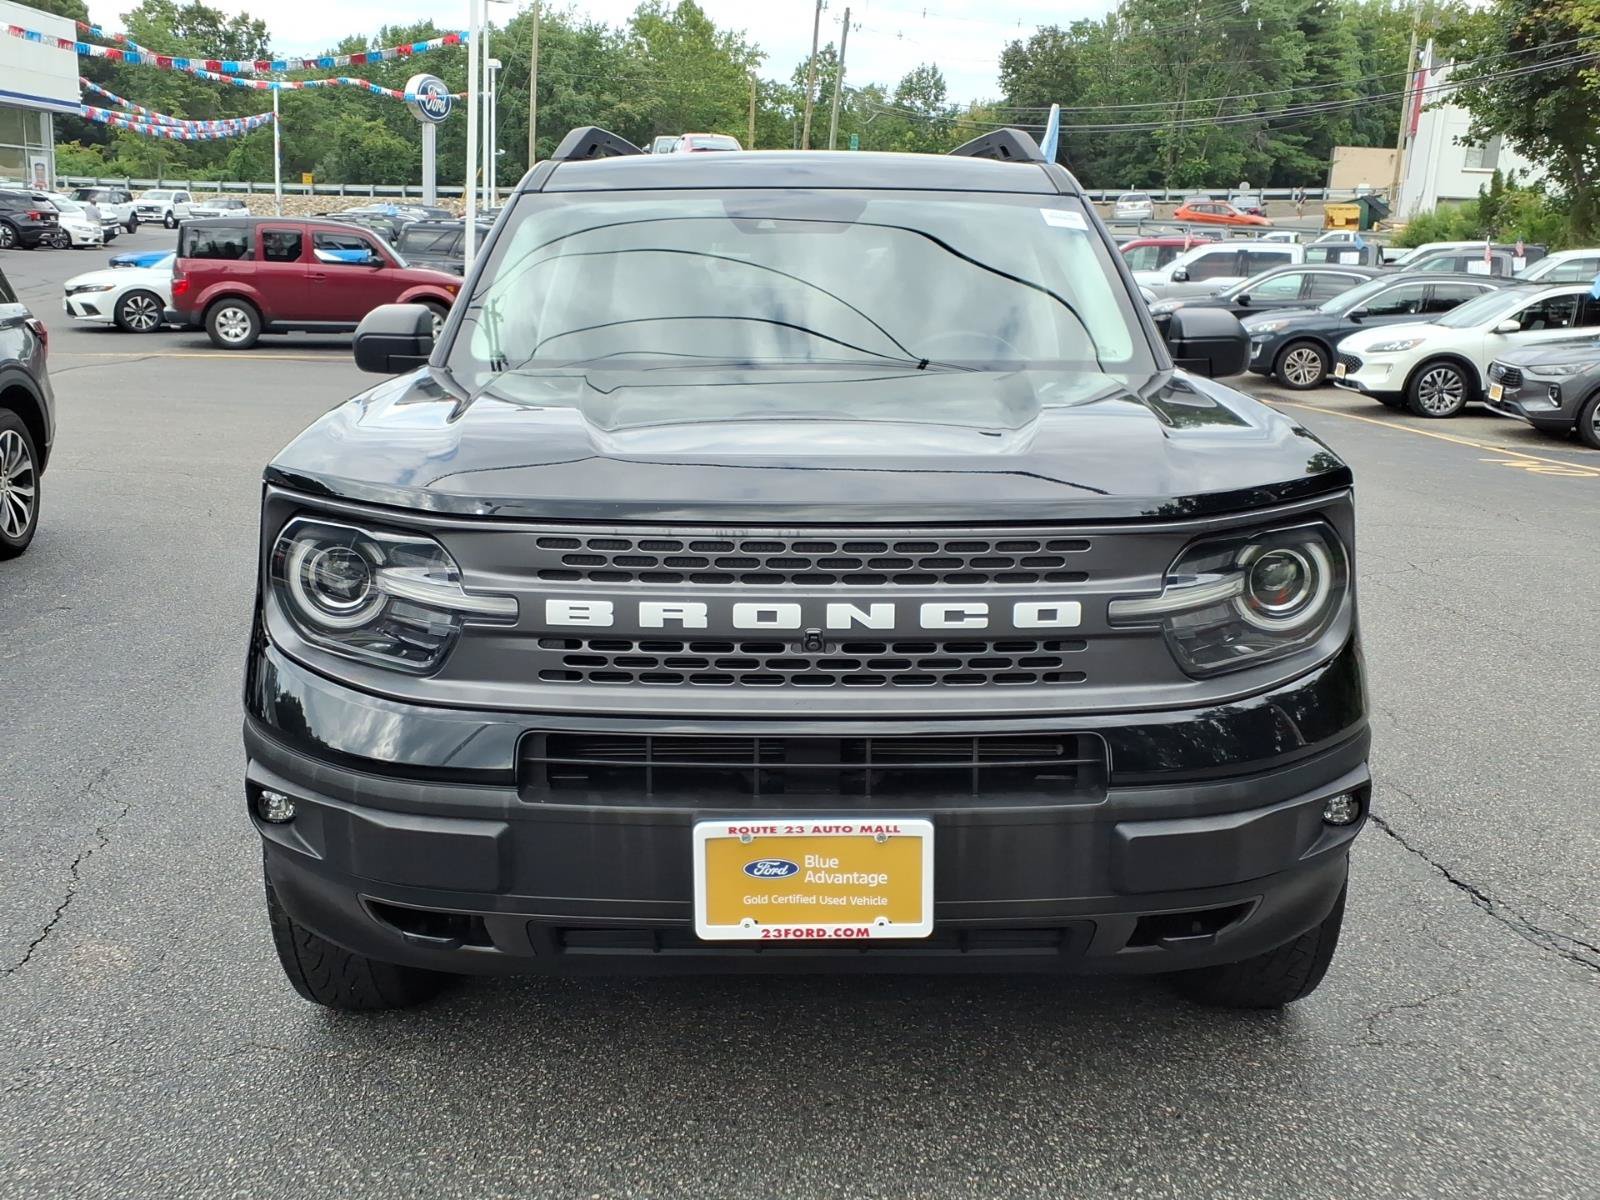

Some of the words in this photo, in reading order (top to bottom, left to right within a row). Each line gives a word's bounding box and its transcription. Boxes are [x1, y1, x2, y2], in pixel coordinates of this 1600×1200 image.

[545, 599, 1082, 629] BRONCO
[728, 826, 777, 835] ROUTE
[785, 826, 804, 834] 23
[811, 825, 853, 834] AUTO
[859, 825, 901, 833] MALL
[753, 860, 789, 876] Ford
[804, 855, 839, 869] Blue
[804, 870, 888, 887] Advantage
[743, 895, 768, 905] Gold
[771, 894, 816, 905] Certified
[819, 895, 847, 906] Used
[849, 895, 888, 906] Vehicle
[761, 928, 870, 939] 23FORD.COM
